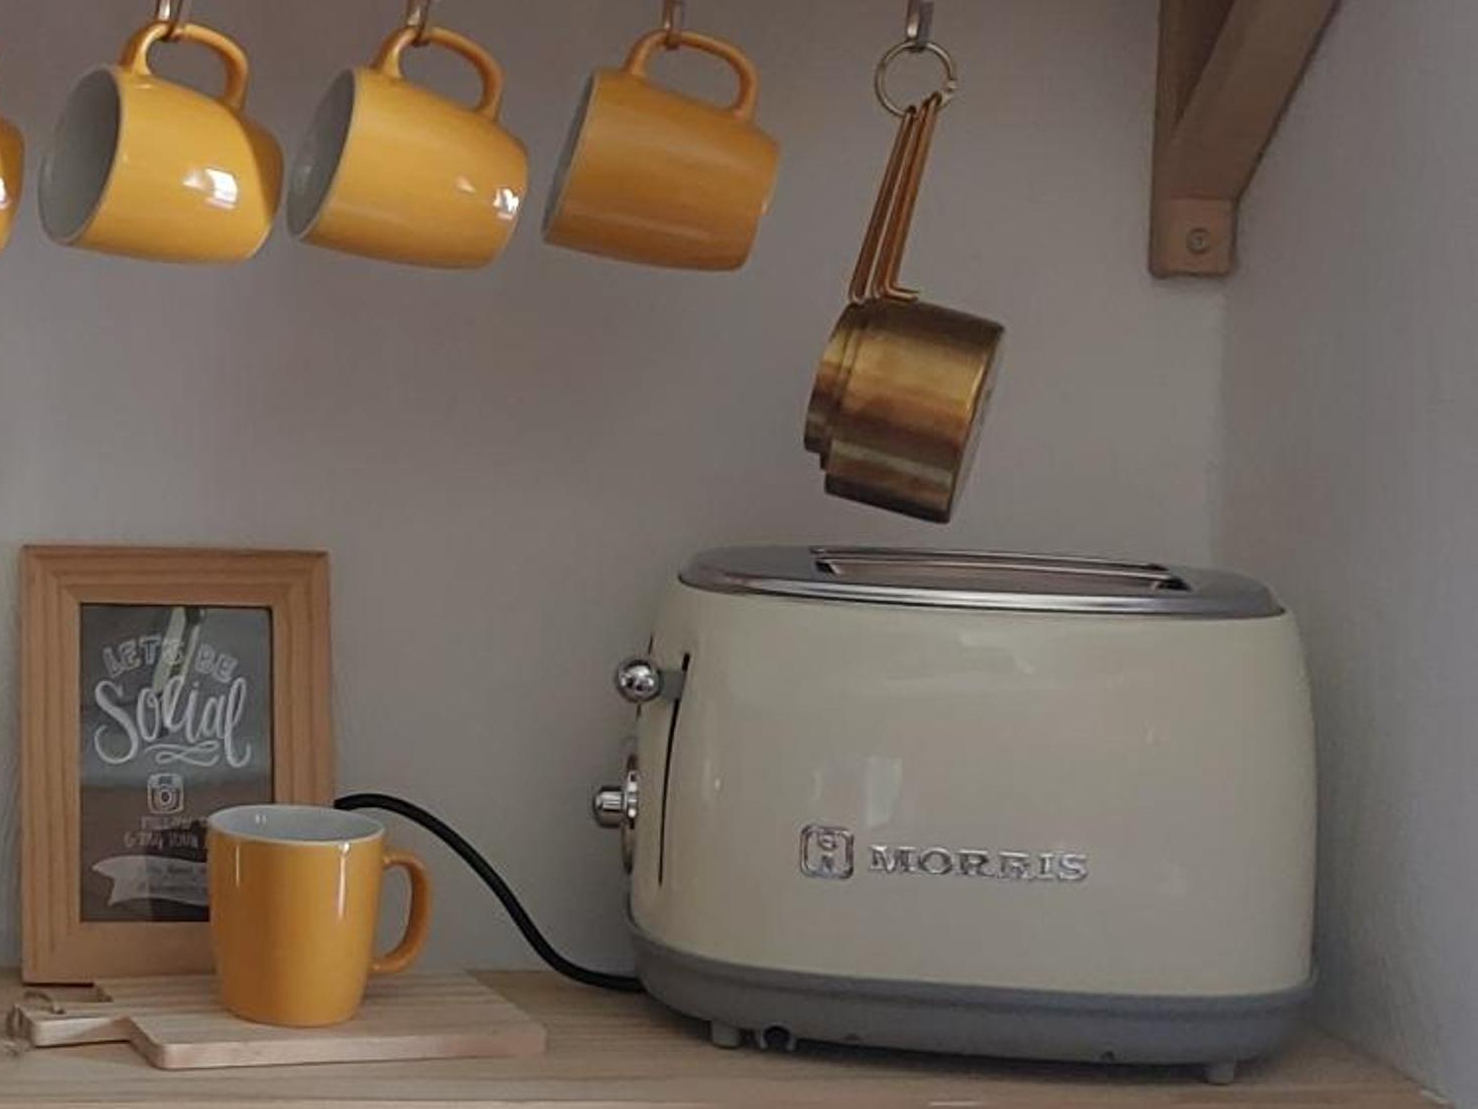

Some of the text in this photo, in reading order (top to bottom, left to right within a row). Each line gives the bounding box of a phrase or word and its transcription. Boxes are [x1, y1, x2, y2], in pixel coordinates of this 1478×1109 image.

[194, 642, 238, 683] BE
[94, 677, 251, 768] Social
[869, 844, 1088, 881] MORRIS
